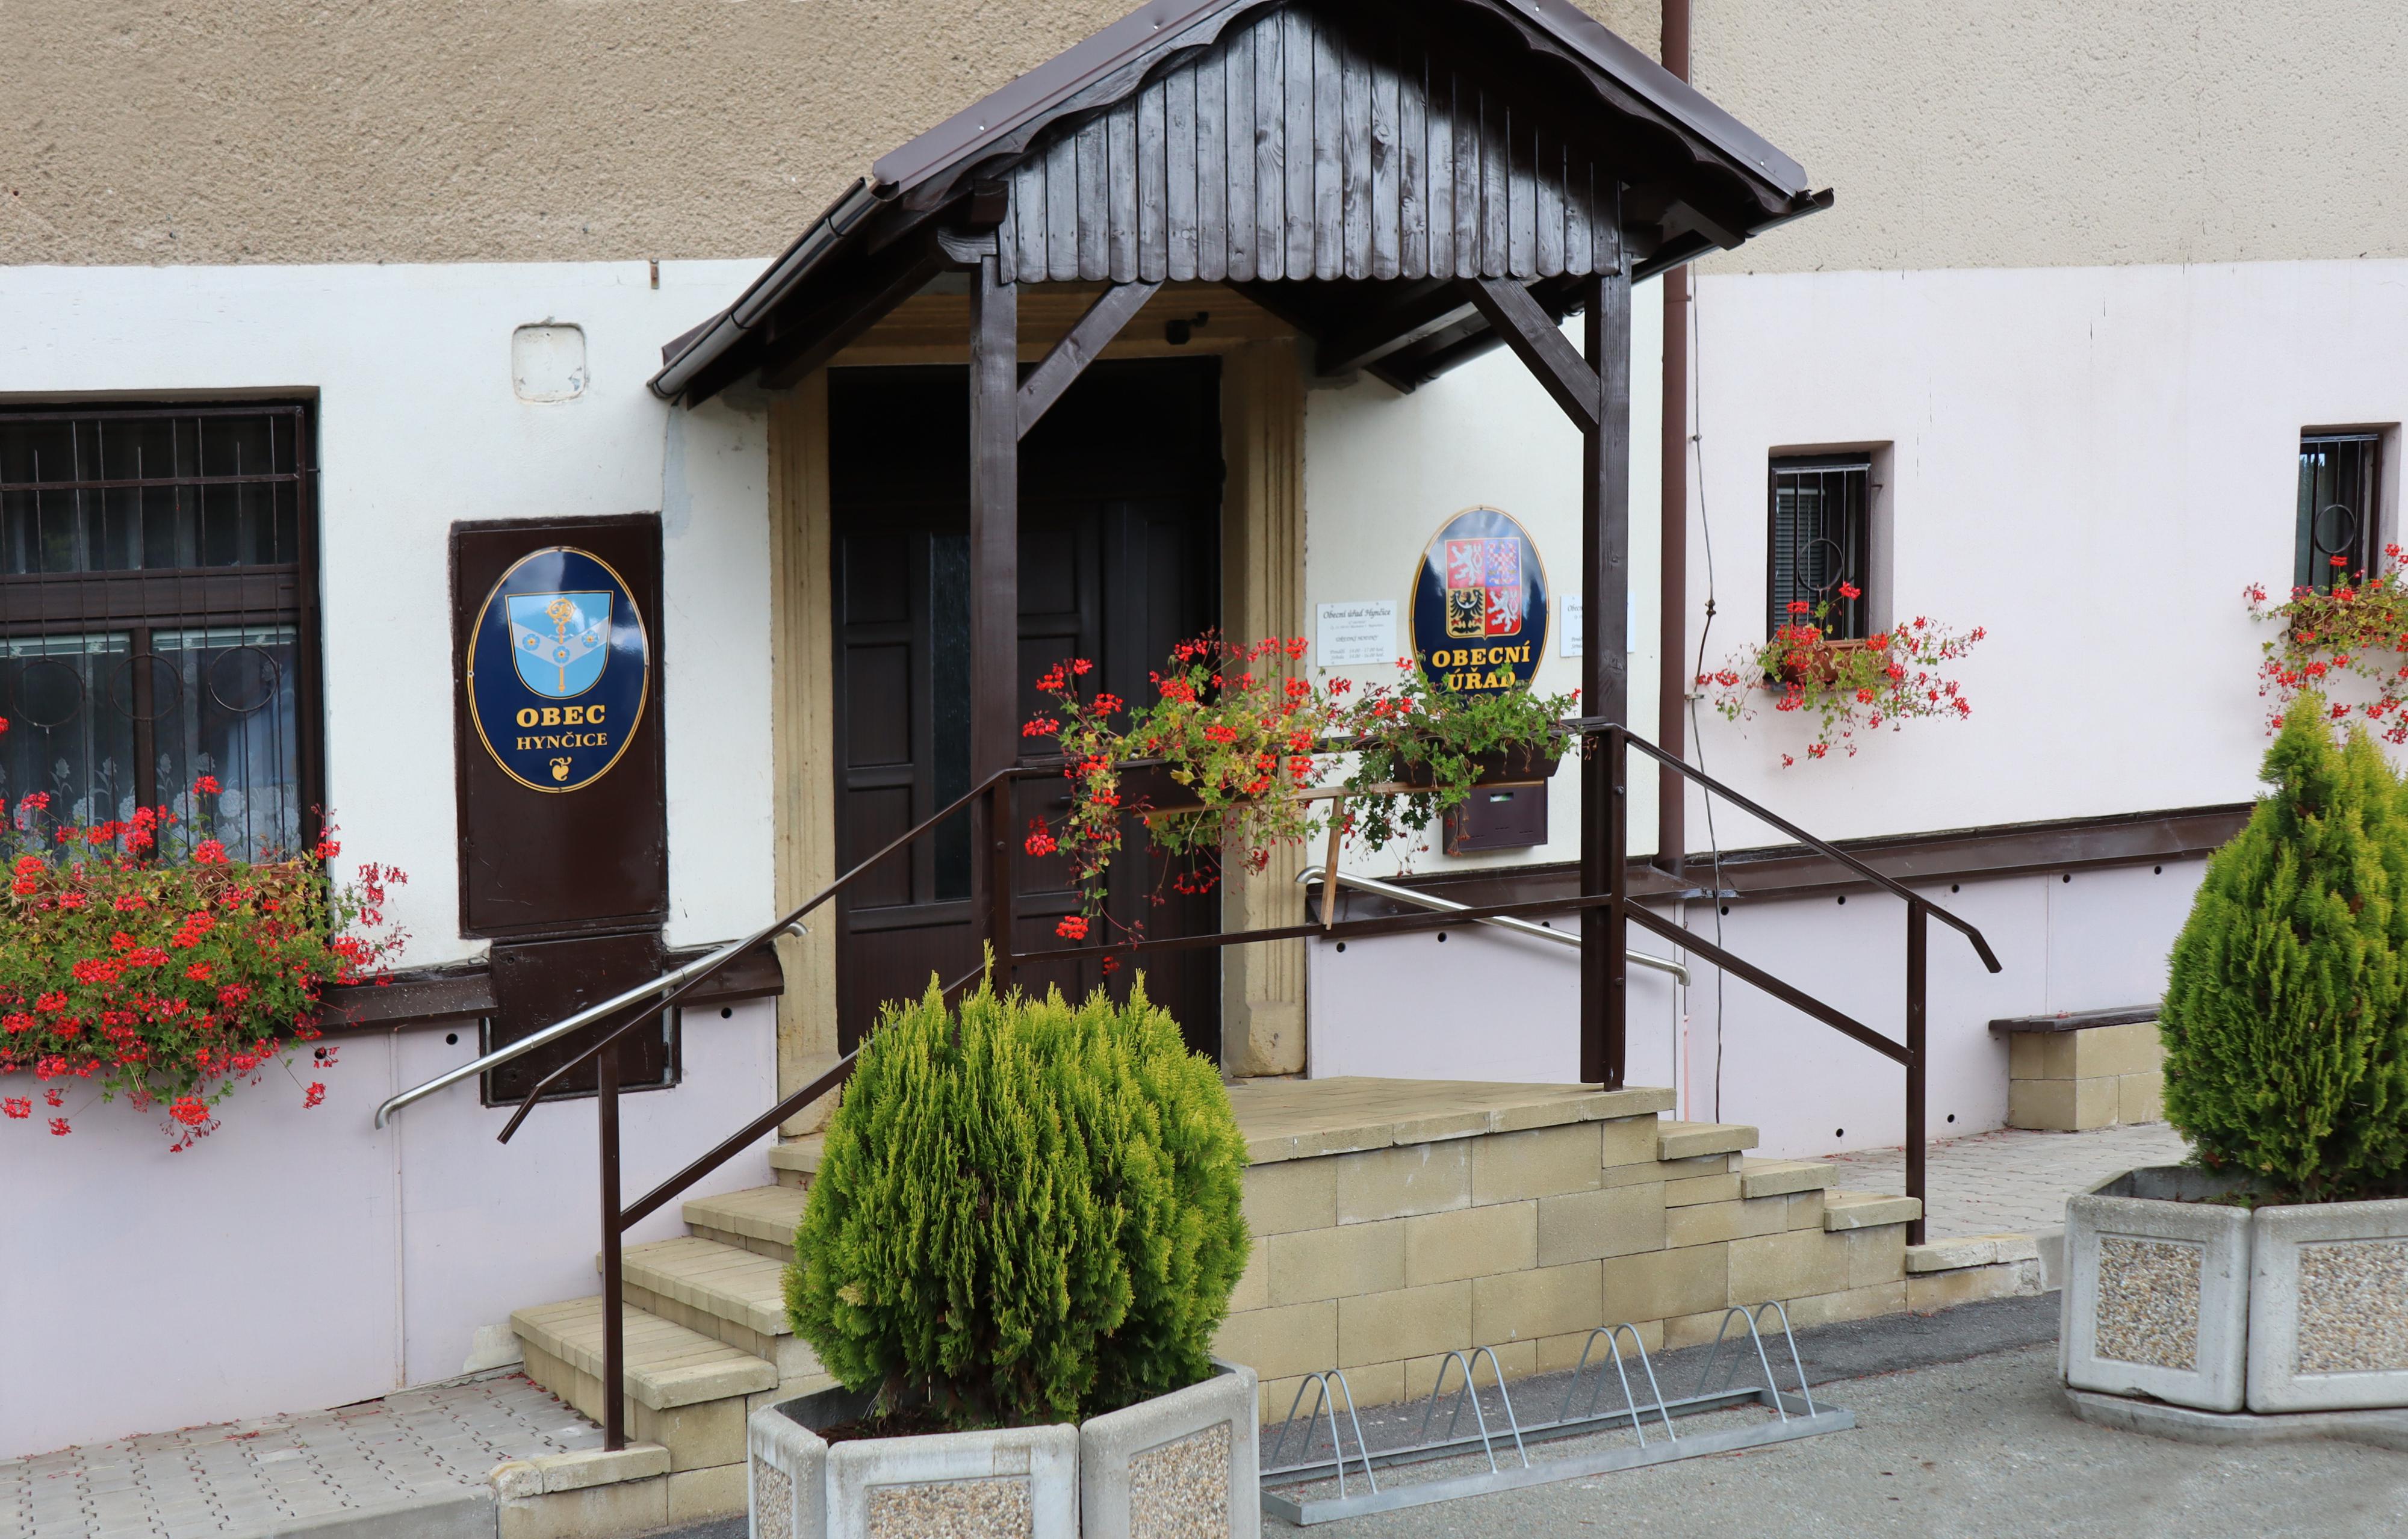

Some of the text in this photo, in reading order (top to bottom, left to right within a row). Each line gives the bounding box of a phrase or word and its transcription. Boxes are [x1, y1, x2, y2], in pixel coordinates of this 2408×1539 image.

[1323, 607, 1391, 619] Obecní úřad Hynčice
[1432, 640, 1530, 668] OBECNÍ
[1448, 667, 1516, 692] ÚŘAD
[516, 705, 606, 728] OBEC
[516, 731, 608, 751] HYNČICE
